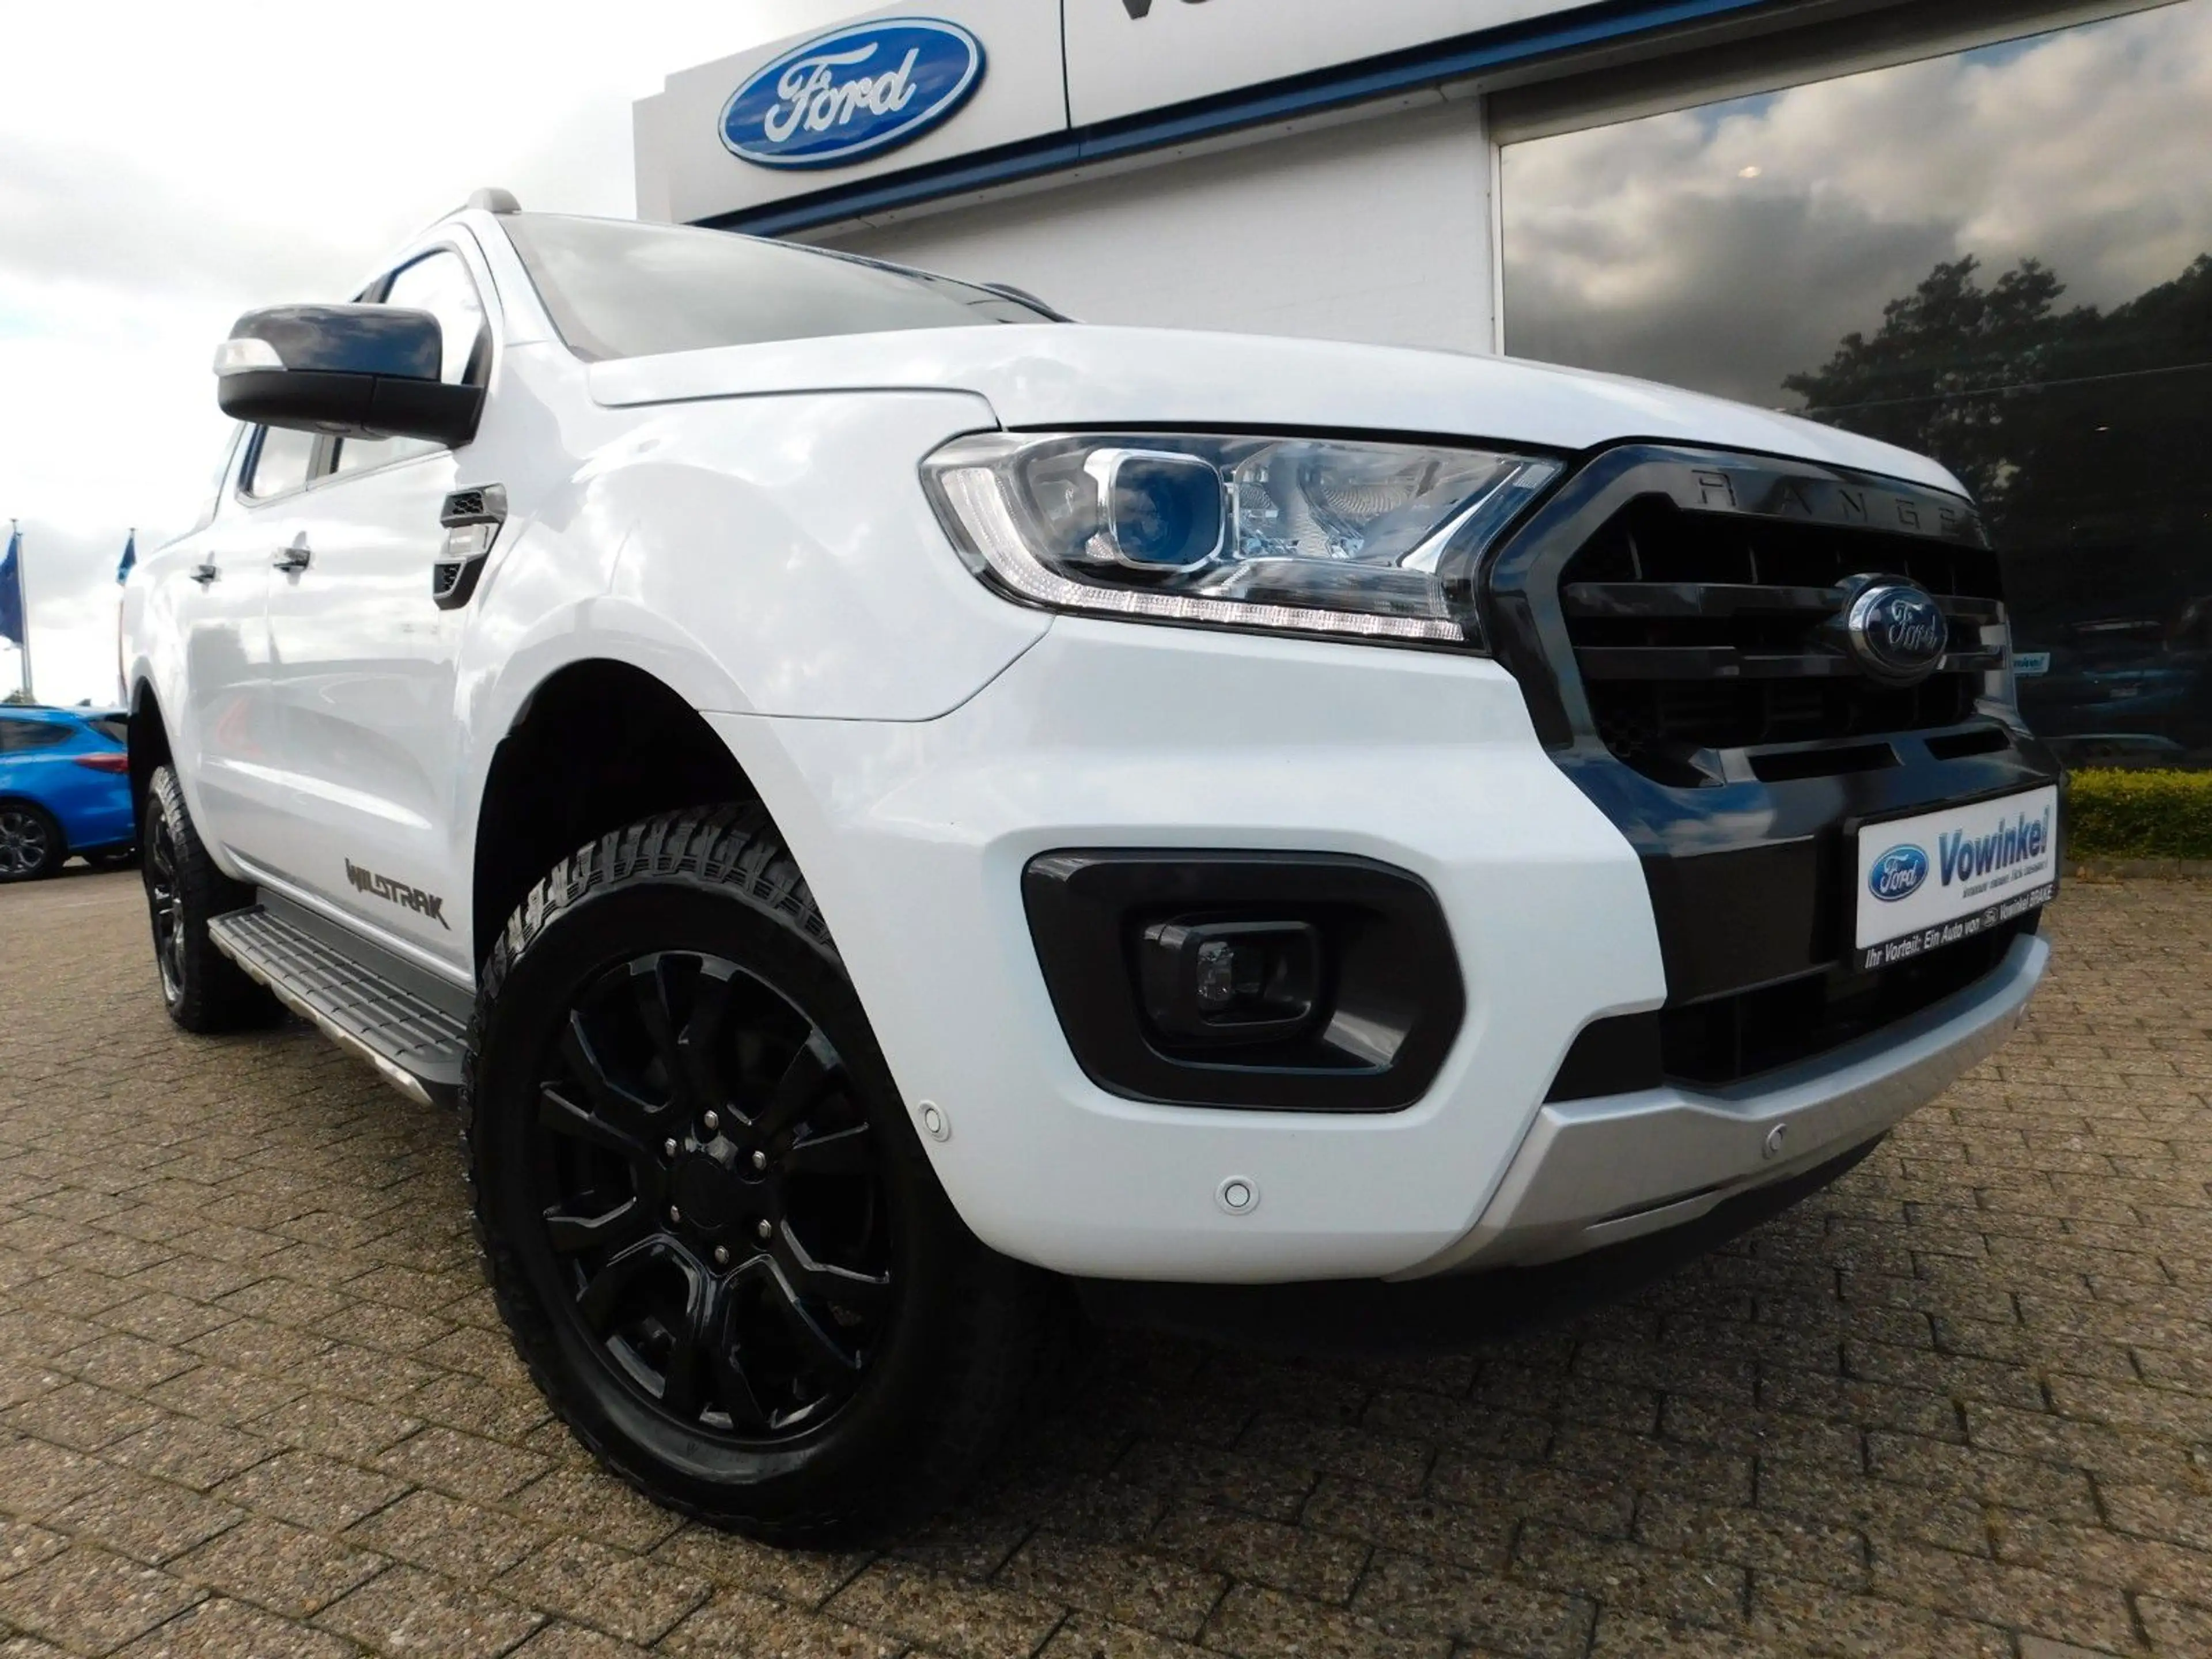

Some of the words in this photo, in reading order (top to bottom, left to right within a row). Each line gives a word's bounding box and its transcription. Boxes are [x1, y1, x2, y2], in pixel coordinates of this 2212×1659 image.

[764, 42, 919, 142] Ford
[1691, 469, 1980, 536] RANGE
[1888, 601, 1937, 650] Ford
[1880, 854, 1918, 892] Ford
[1939, 805, 2049, 886] Vowinkel
[345, 857, 451, 930] WILDTRAK
[1865, 949, 1882, 968] Ihr
[1885, 937, 1920, 964] Vorteil:
[1924, 930, 1940, 949] Ein
[1941, 922, 1963, 944] Auto
[1965, 918, 1980, 934] von
